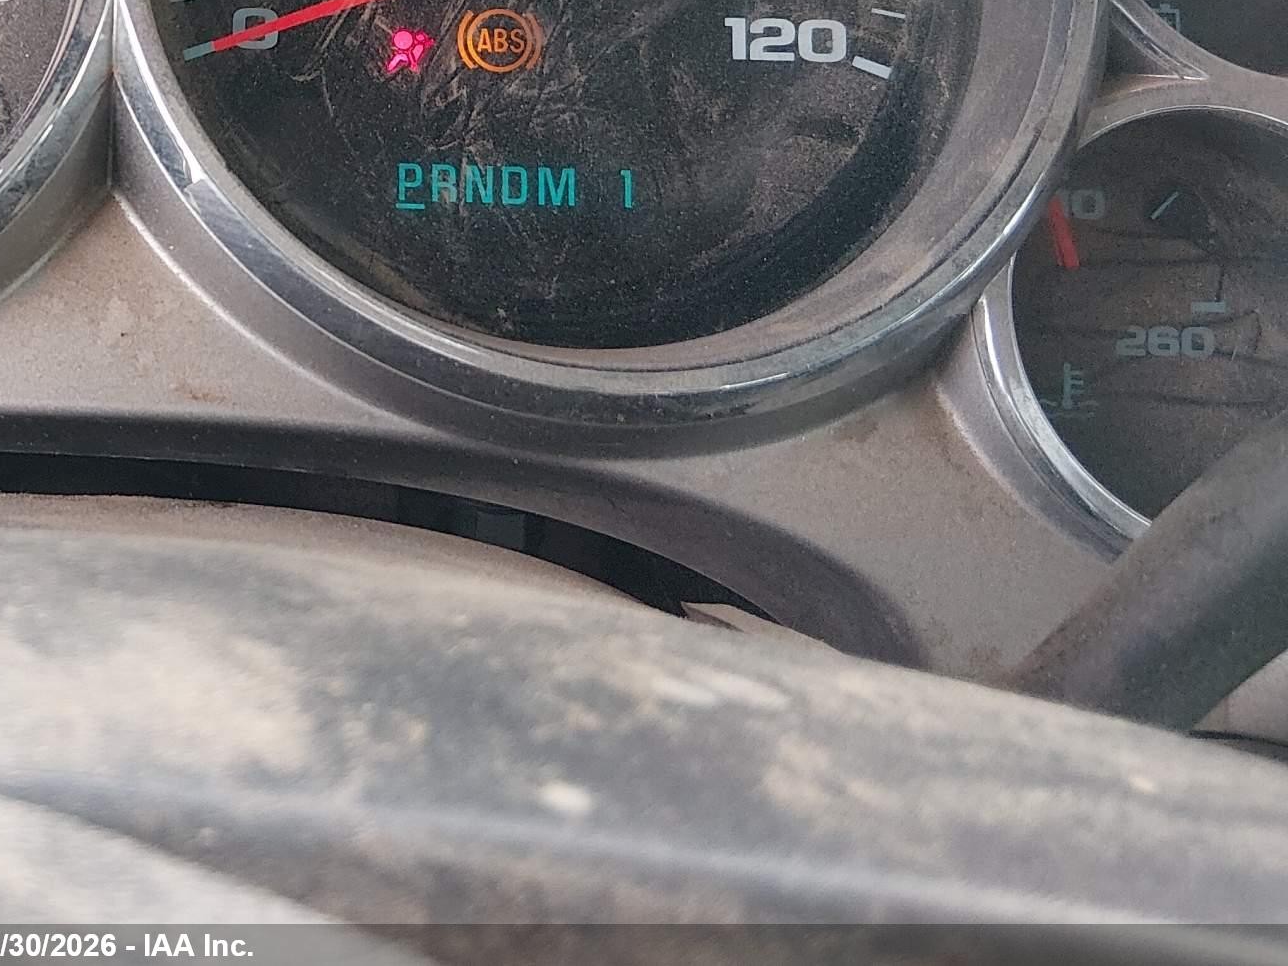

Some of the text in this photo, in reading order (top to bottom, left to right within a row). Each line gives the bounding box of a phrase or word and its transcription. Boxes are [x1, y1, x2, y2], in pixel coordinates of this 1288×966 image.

[231, 7, 280, 51] 0
[475, 27, 527, 53] ABS
[724, 18, 847, 63] 120
[395, 162, 577, 208] PRNDM
[1115, 325, 1213, 358] 260
